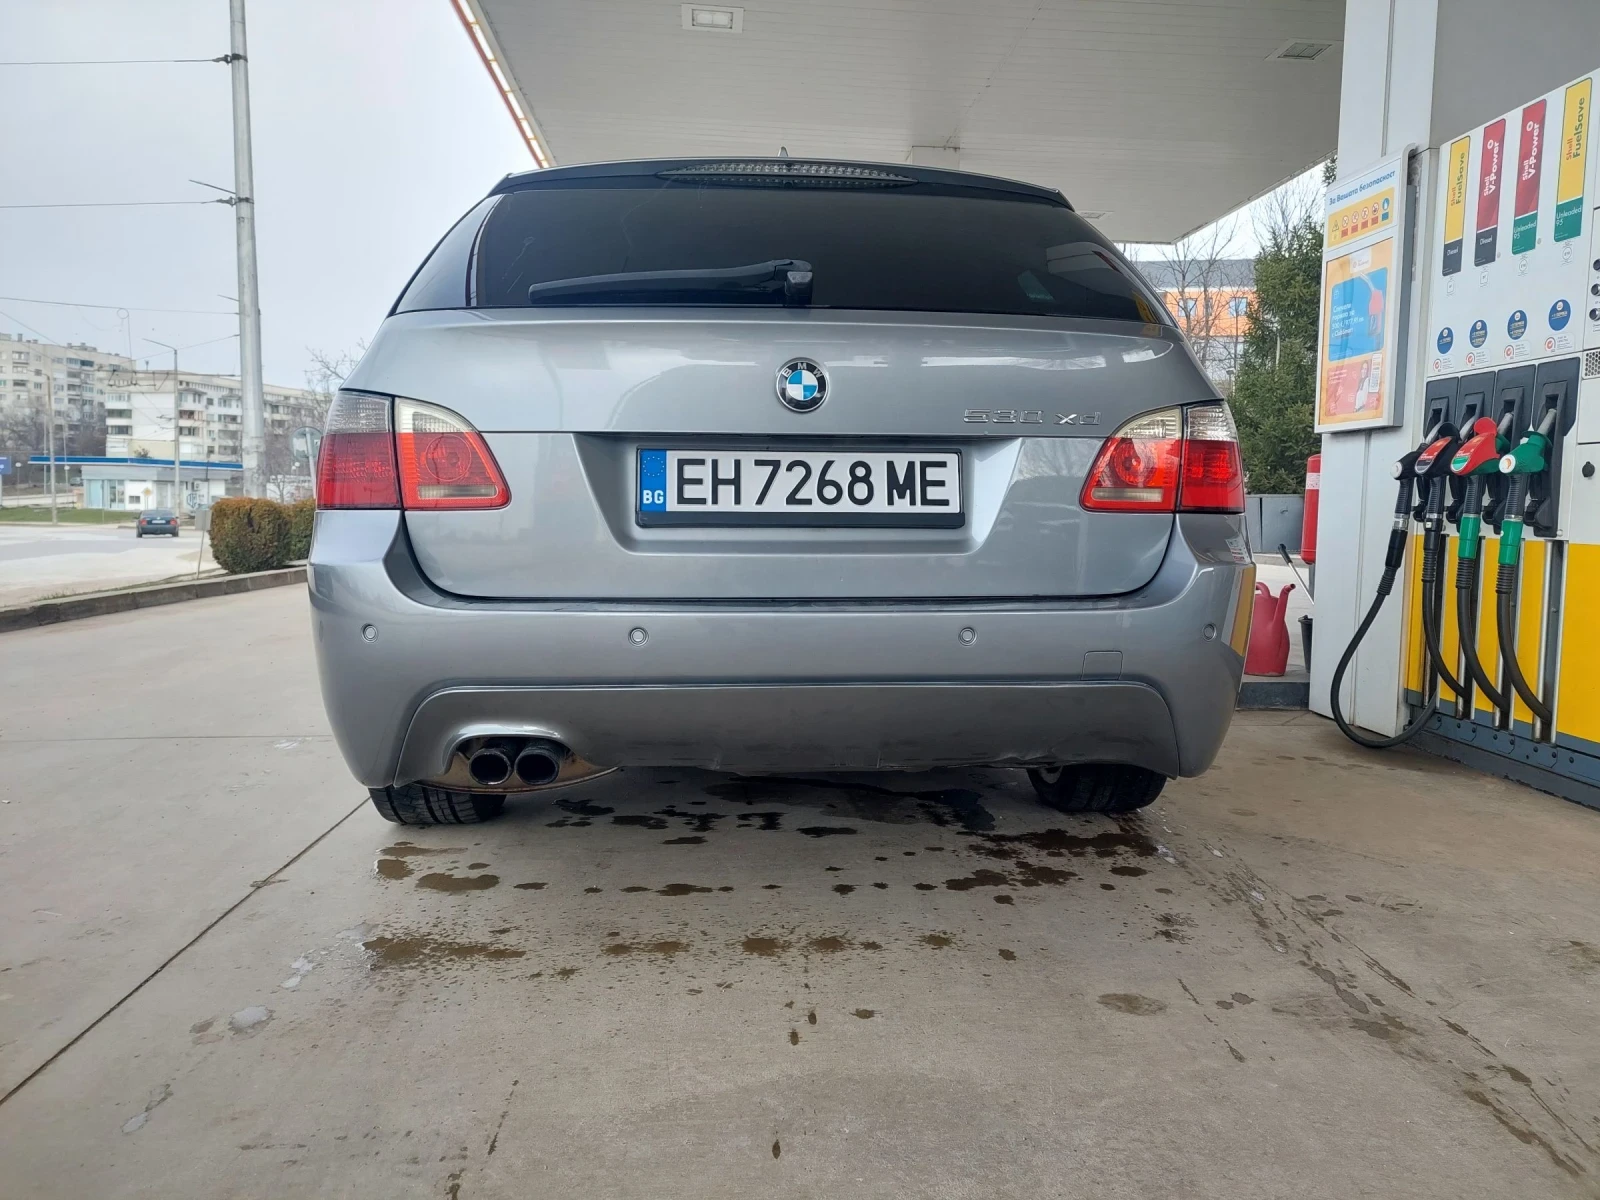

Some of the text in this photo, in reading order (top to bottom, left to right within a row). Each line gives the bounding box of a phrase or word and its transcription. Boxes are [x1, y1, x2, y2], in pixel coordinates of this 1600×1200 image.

[1573, 97, 1585, 159] FuelSave
[1528, 123, 1540, 179] V-Power
[1488, 141, 1500, 194] V-Power
[1455, 152, 1465, 204] FuelSave
[1337, 188, 1358, 202] Вашата
[1359, 171, 1395, 192] безопасност
[1556, 205, 1582, 219] Unleaded
[1513, 219, 1537, 234] Unleaded
[1479, 236, 1493, 246] Diesel
[1514, 232, 1521, 240] 95
[1446, 247, 1459, 257] Diesel
[781, 362, 823, 378] BMW
[963, 408, 1101, 425] 530 xd
[676, 458, 950, 507] EH 7268 ME
[643, 489, 664, 504] BG
